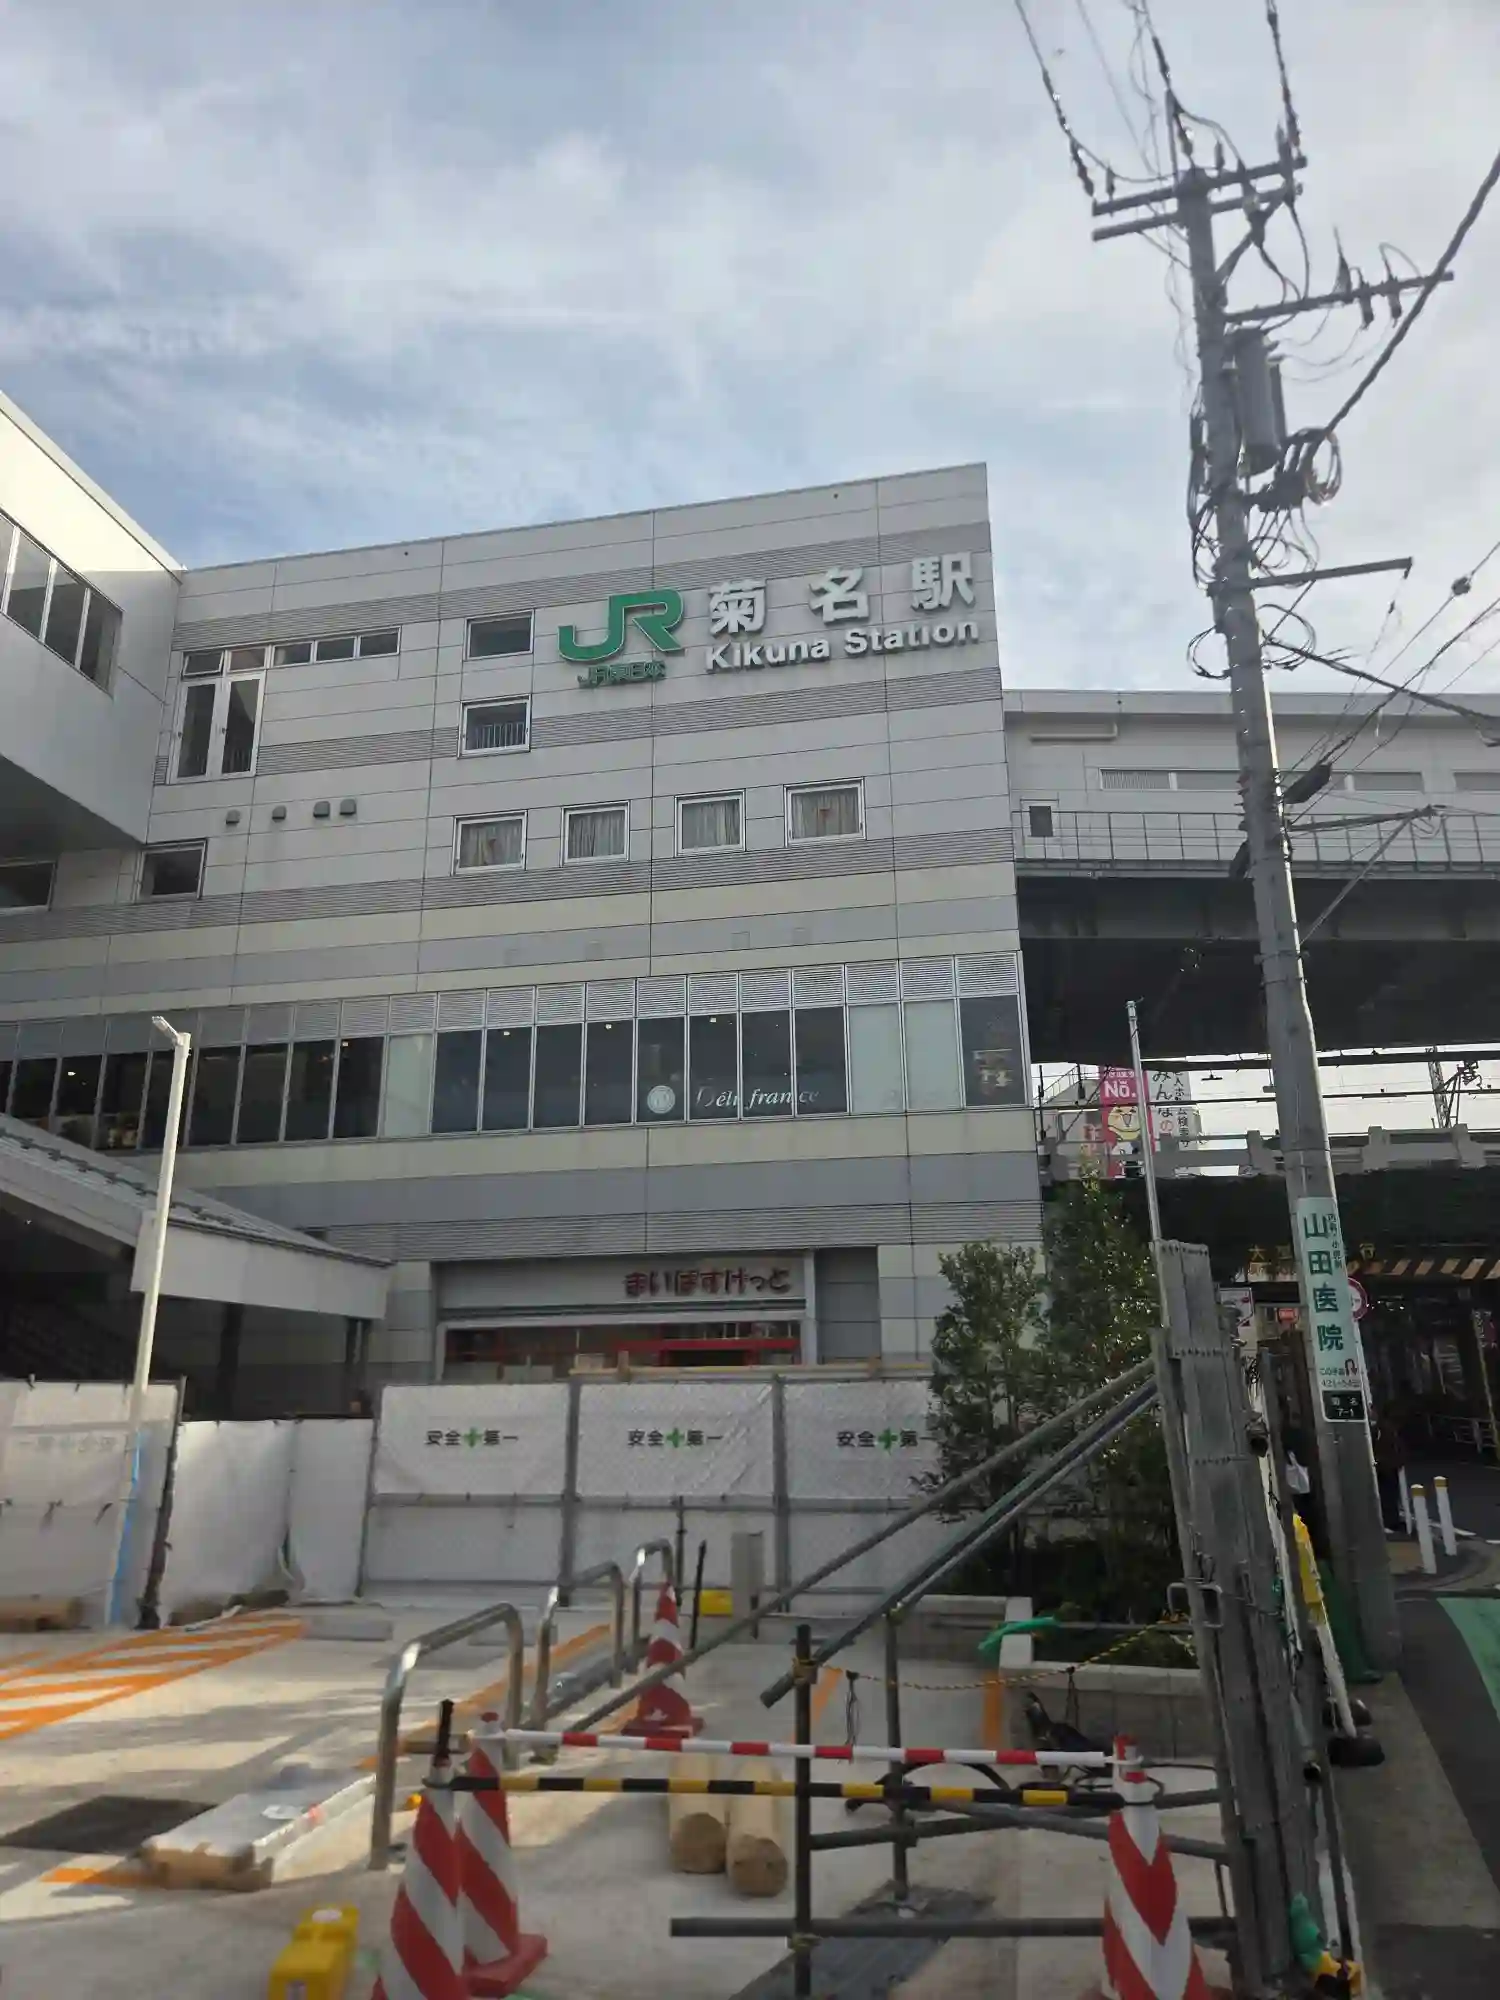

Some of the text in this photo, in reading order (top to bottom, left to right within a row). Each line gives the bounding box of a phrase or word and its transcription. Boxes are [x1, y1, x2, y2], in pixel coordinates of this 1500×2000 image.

[708, 551, 975, 634] 菊名駅
[558, 587, 684, 662] JR
[704, 620, 979, 672] Kikuna Station
[624, 1267, 790, 1298] まいばすけっと
[1303, 1213, 1343, 1351] 山田医院
[1336, 1408, 1354, 1417] 7-1
